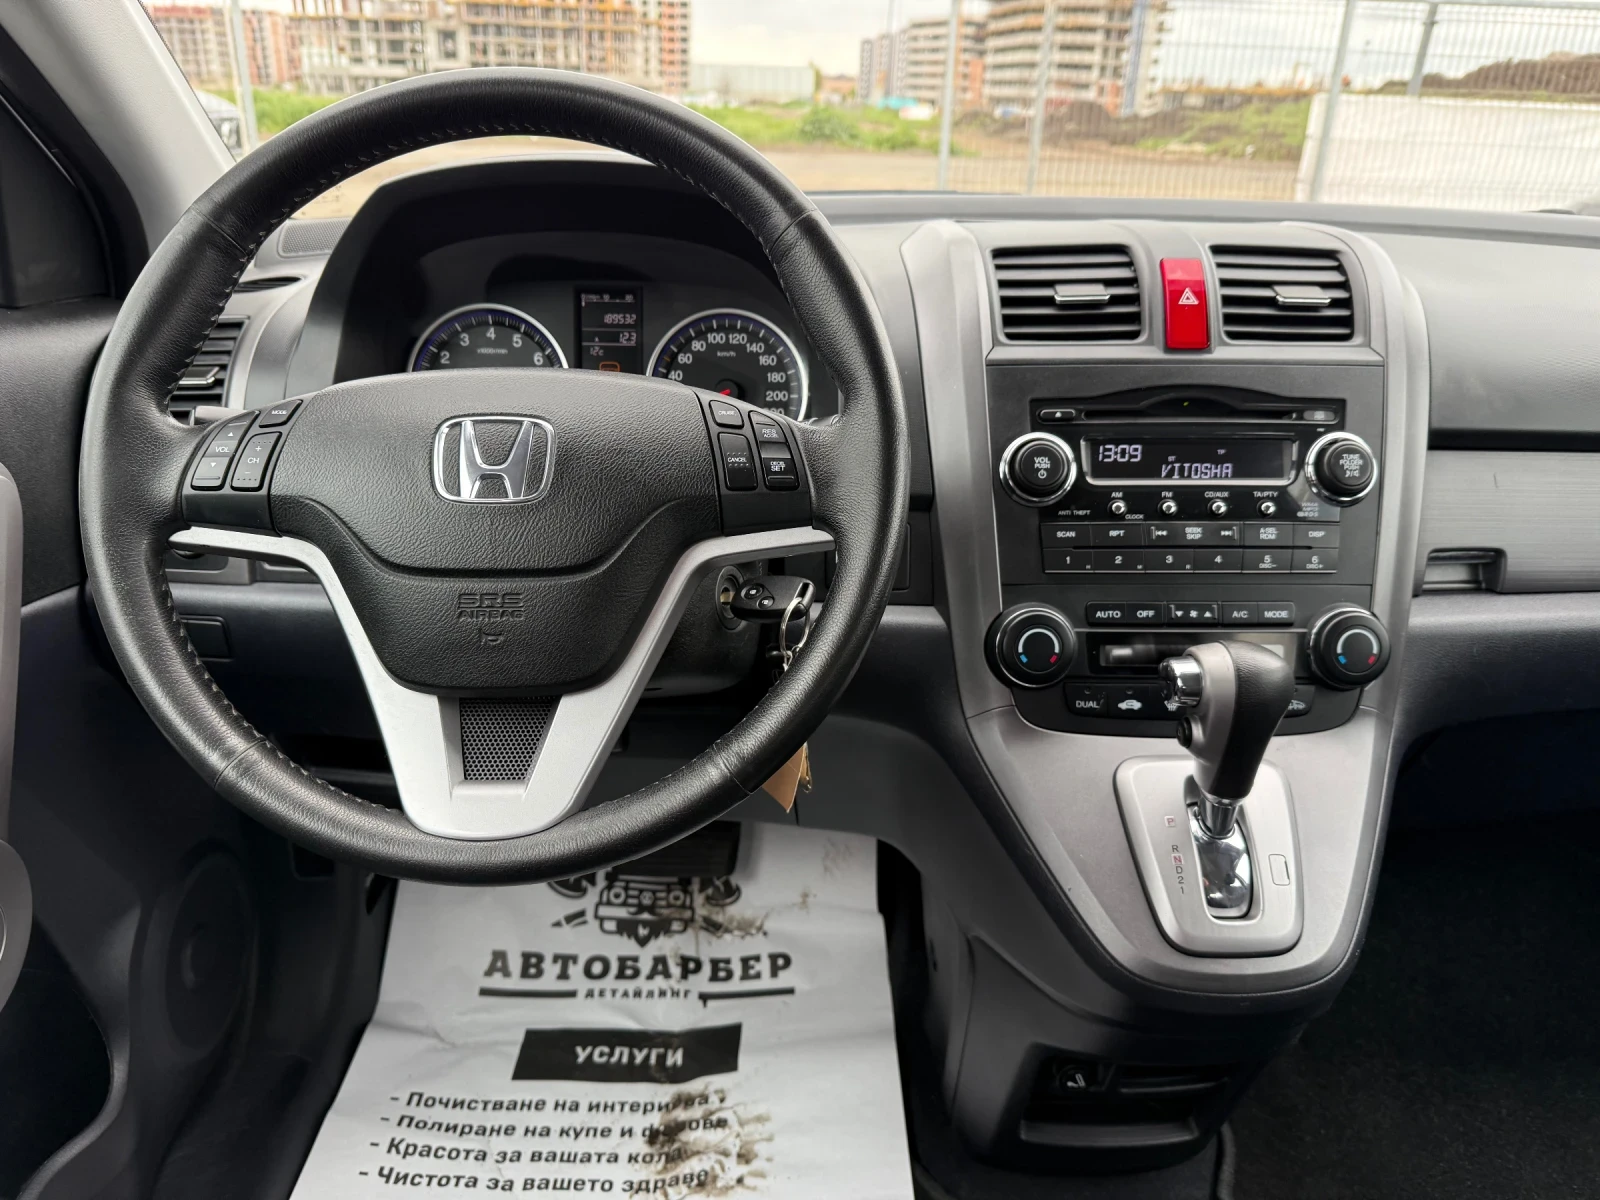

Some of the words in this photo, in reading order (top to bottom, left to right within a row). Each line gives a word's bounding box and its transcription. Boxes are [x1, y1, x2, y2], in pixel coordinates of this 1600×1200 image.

[486, 327, 496, 340] 4
[707, 333, 726, 344] 100
[728, 333, 747, 344] 120
[460, 333, 470, 346] 3
[512, 334, 522, 347] 5
[691, 341, 706, 351] 80
[746, 342, 764, 353] 140
[440, 352, 450, 364] 2
[533, 352, 543, 365] 6
[678, 353, 693, 364] 60
[759, 355, 777, 366] 160
[668, 370, 683, 380] 40
[767, 372, 786, 383] 180
[766, 391, 788, 401] 200
[1099, 445, 1142, 462] 13:09
[1161, 463, 1233, 478] VITOSHA
[1066, 556, 1070, 564] 1
[1115, 556, 1122, 564] 2
[1166, 555, 1173, 563] 3
[1214, 555, 1222, 563] 4
[1264, 555, 1271, 563] 5
[459, 593, 524, 608] SRS
[458, 609, 524, 620] AIRBAG
[1095, 611, 1121, 619] AUTO
[1136, 610, 1155, 619] OFF
[1232, 610, 1248, 619] A/C
[1264, 611, 1288, 619] MODE
[1075, 701, 1098, 709] DUAL
[1176, 866, 1183, 874] D
[1178, 876, 1184, 884] 2
[483, 949, 793, 983] АВТОБАРБЕР
[584, 986, 692, 1000] ДЕТАЙЛИНГ
[574, 1045, 685, 1068] УСЛУГИ
[406, 1092, 546, 1112] Почистване
[553, 1100, 580, 1113] на
[397, 1115, 516, 1138] Полиране
[523, 1125, 551, 1138] на
[559, 1127, 612, 1141] купе
[620, 1127, 634, 1138] и
[386, 1137, 487, 1162] Красота
[494, 1150, 522, 1164] за
[529, 1150, 619, 1165] вашата
[377, 1166, 478, 1189] Чистота
[486, 1178, 514, 1192] за
[522, 1177, 614, 1193] вашето
